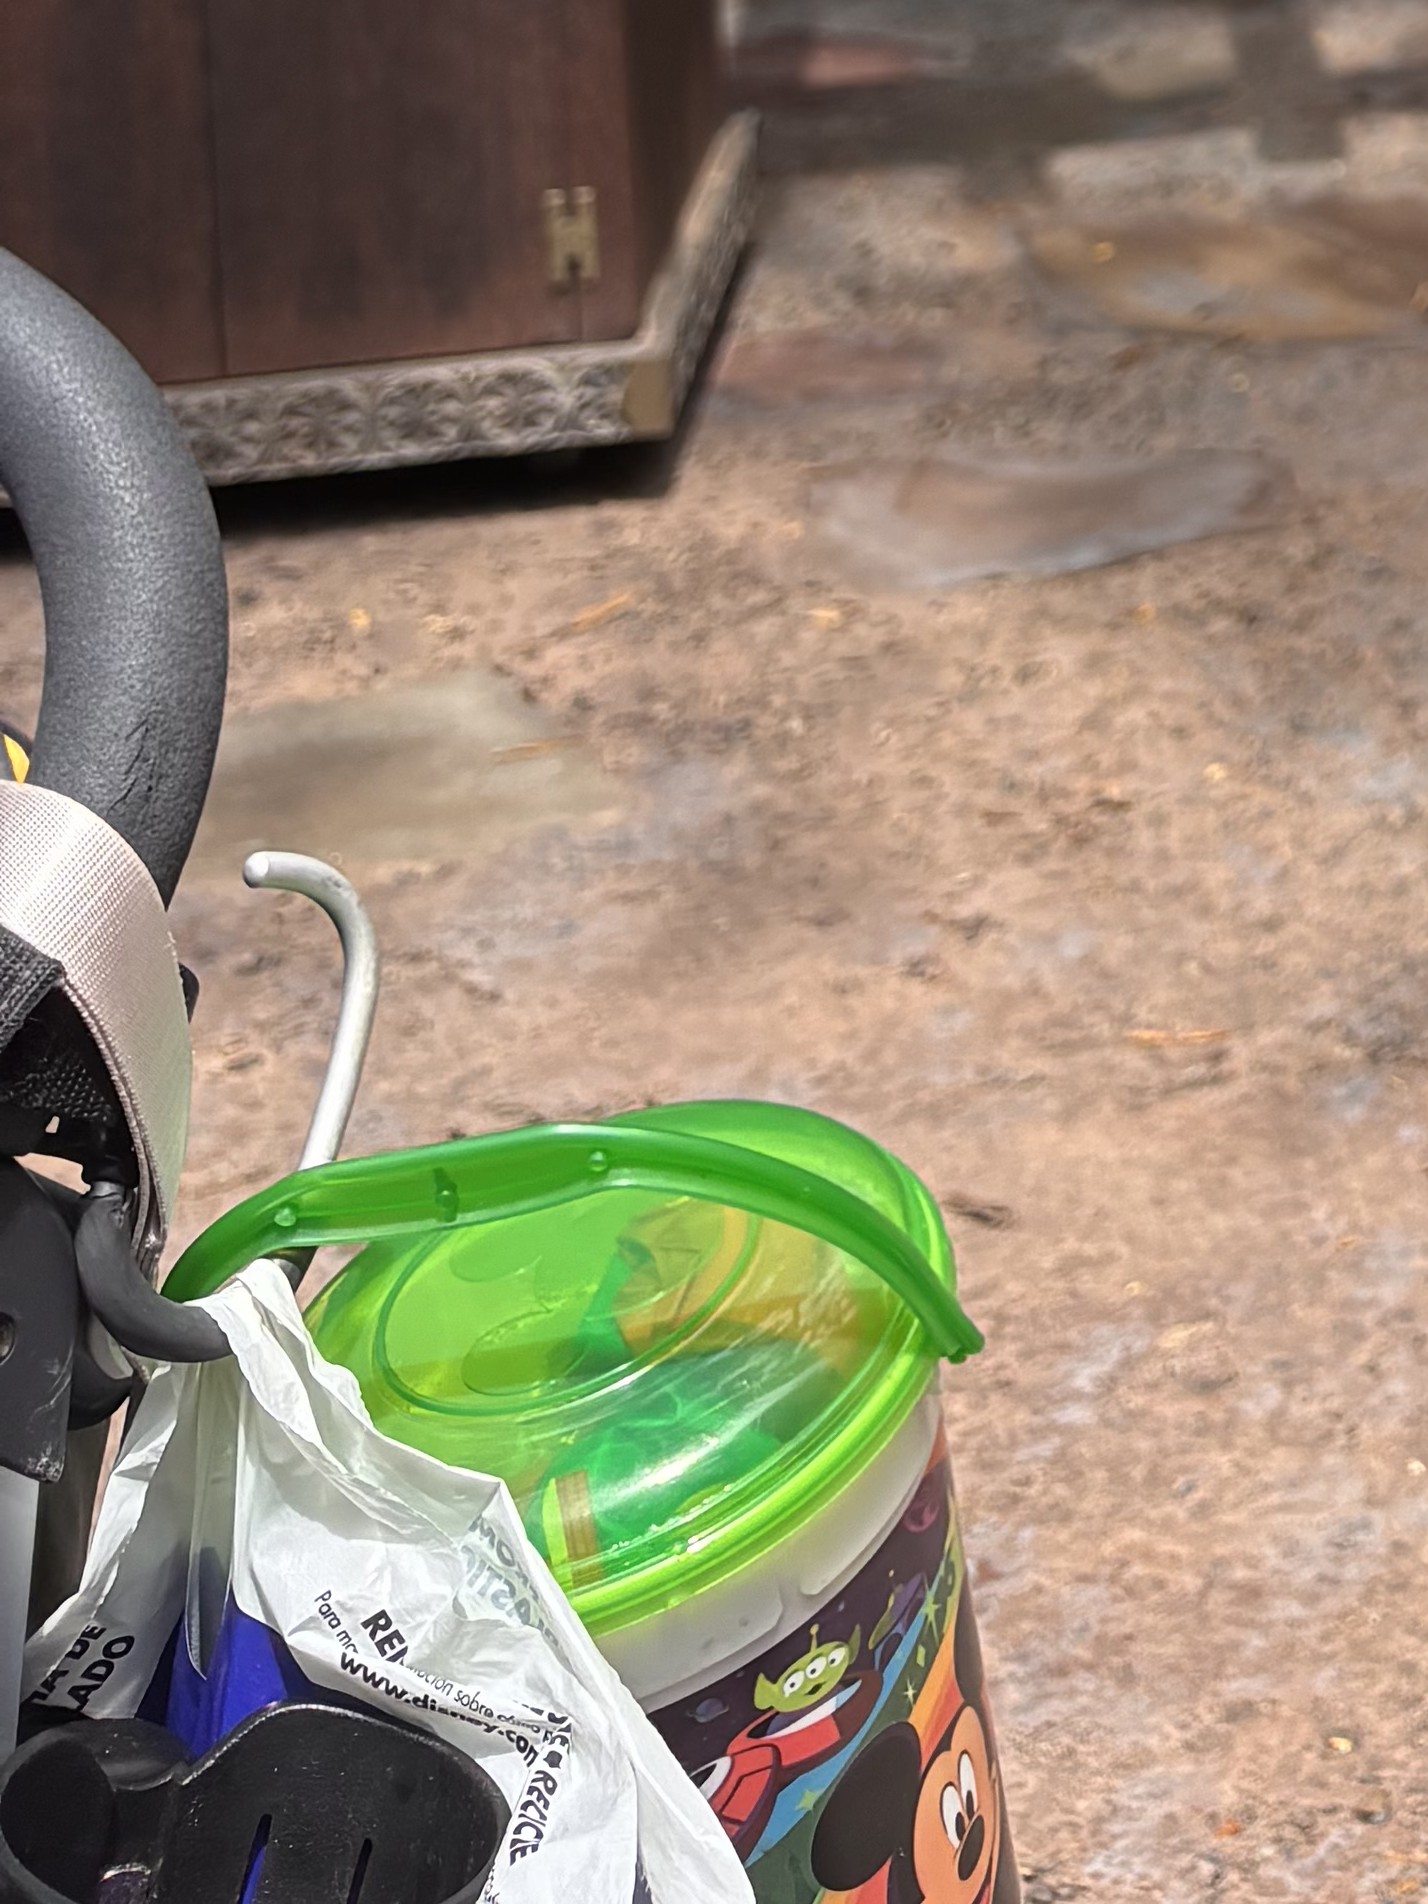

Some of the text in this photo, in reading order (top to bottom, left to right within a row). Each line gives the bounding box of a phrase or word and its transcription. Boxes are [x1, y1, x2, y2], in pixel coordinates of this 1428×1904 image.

[66, 1635, 135, 1711] ADO
[314, 1589, 342, 1630] Para
[453, 1690, 495, 1718] sobre
[510, 1769, 558, 1867] RECICLE
